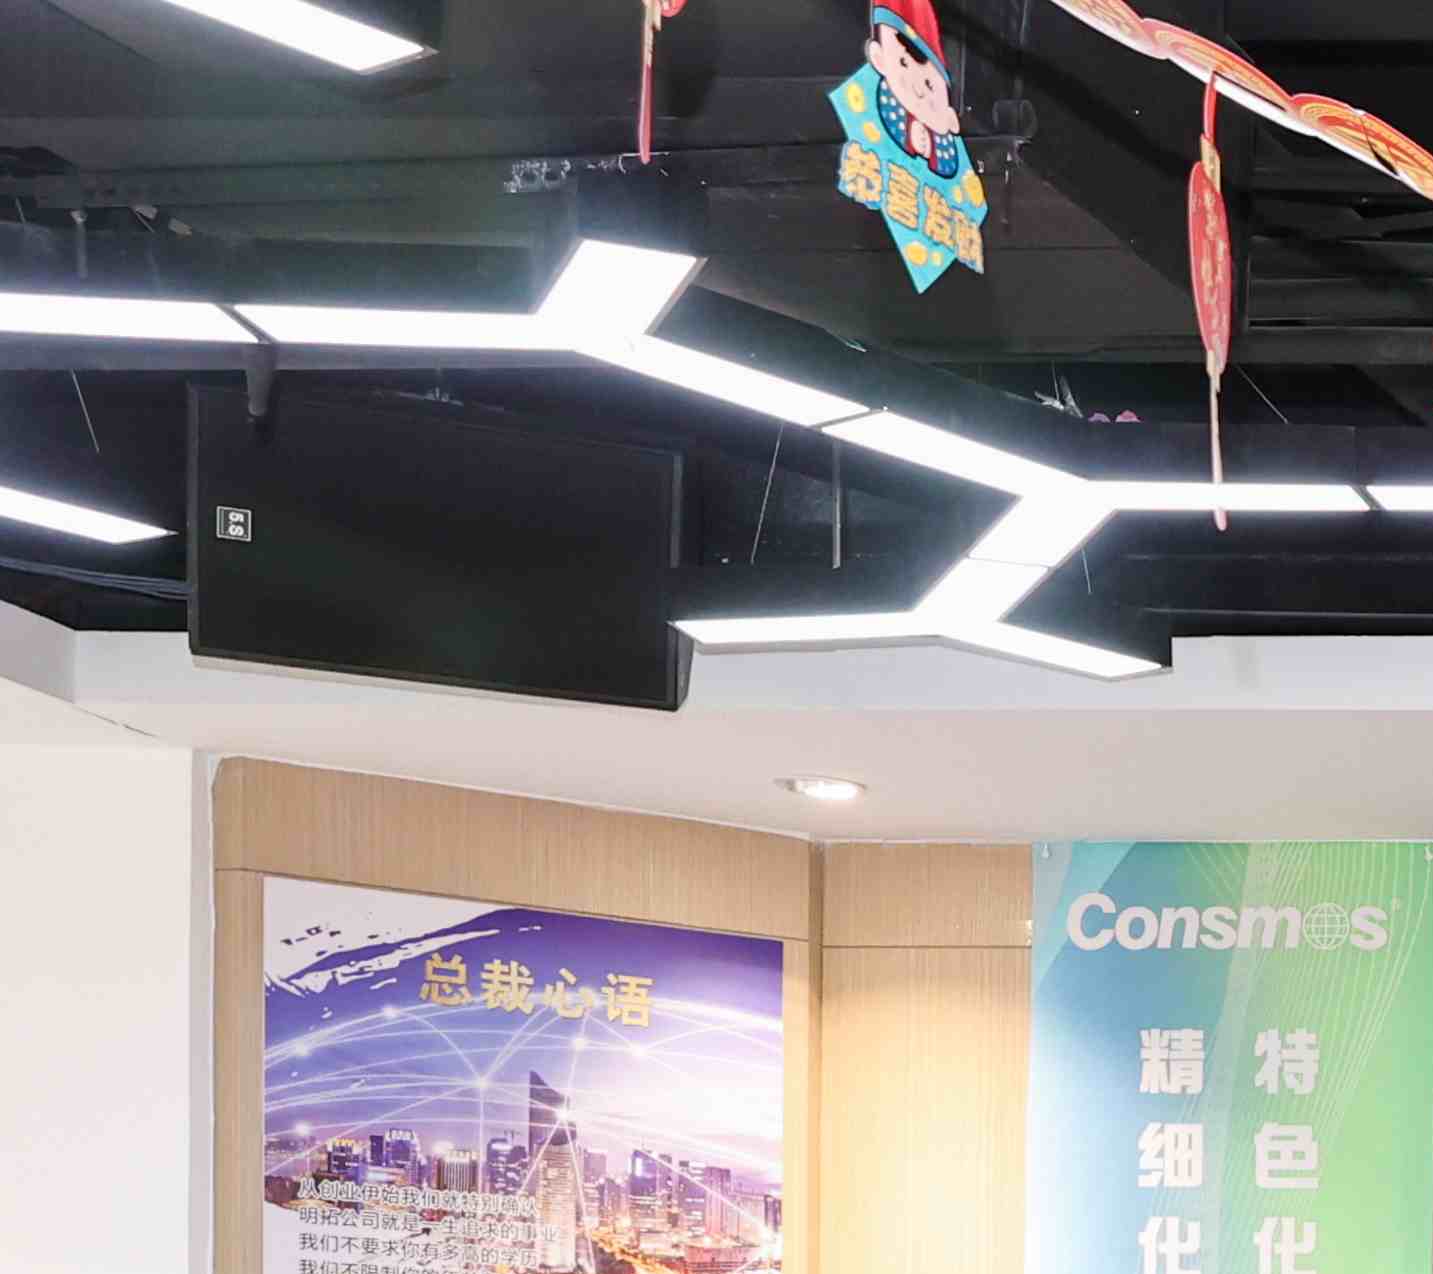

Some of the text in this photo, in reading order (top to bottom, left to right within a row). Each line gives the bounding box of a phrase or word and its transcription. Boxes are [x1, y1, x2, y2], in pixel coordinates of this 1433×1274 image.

[1065, 891, 1390, 951] Consmos
[420, 952, 654, 1028] 总裁心语
